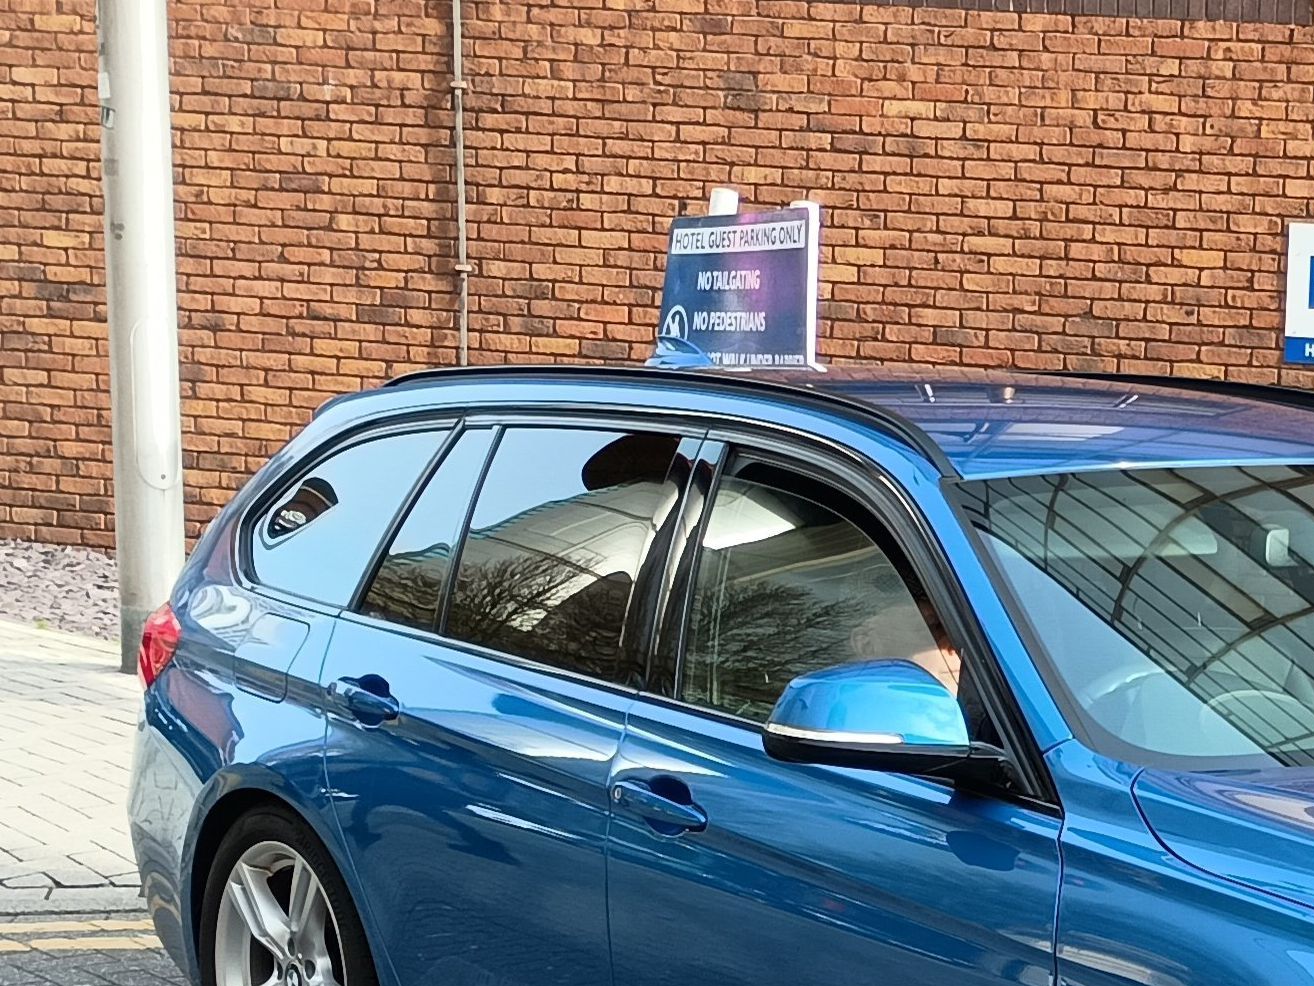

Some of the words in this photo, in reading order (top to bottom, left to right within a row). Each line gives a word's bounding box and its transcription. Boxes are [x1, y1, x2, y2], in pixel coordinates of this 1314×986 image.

[674, 231, 705, 251] HOTEL
[708, 230, 737, 249] GUEST
[739, 227, 776, 248] PARKING
[778, 223, 804, 244] ONLY
[696, 270, 712, 291] NO
[712, 269, 761, 291] TAILGATING
[692, 311, 708, 331] NO
[709, 311, 766, 332] PEDESTRIANS
